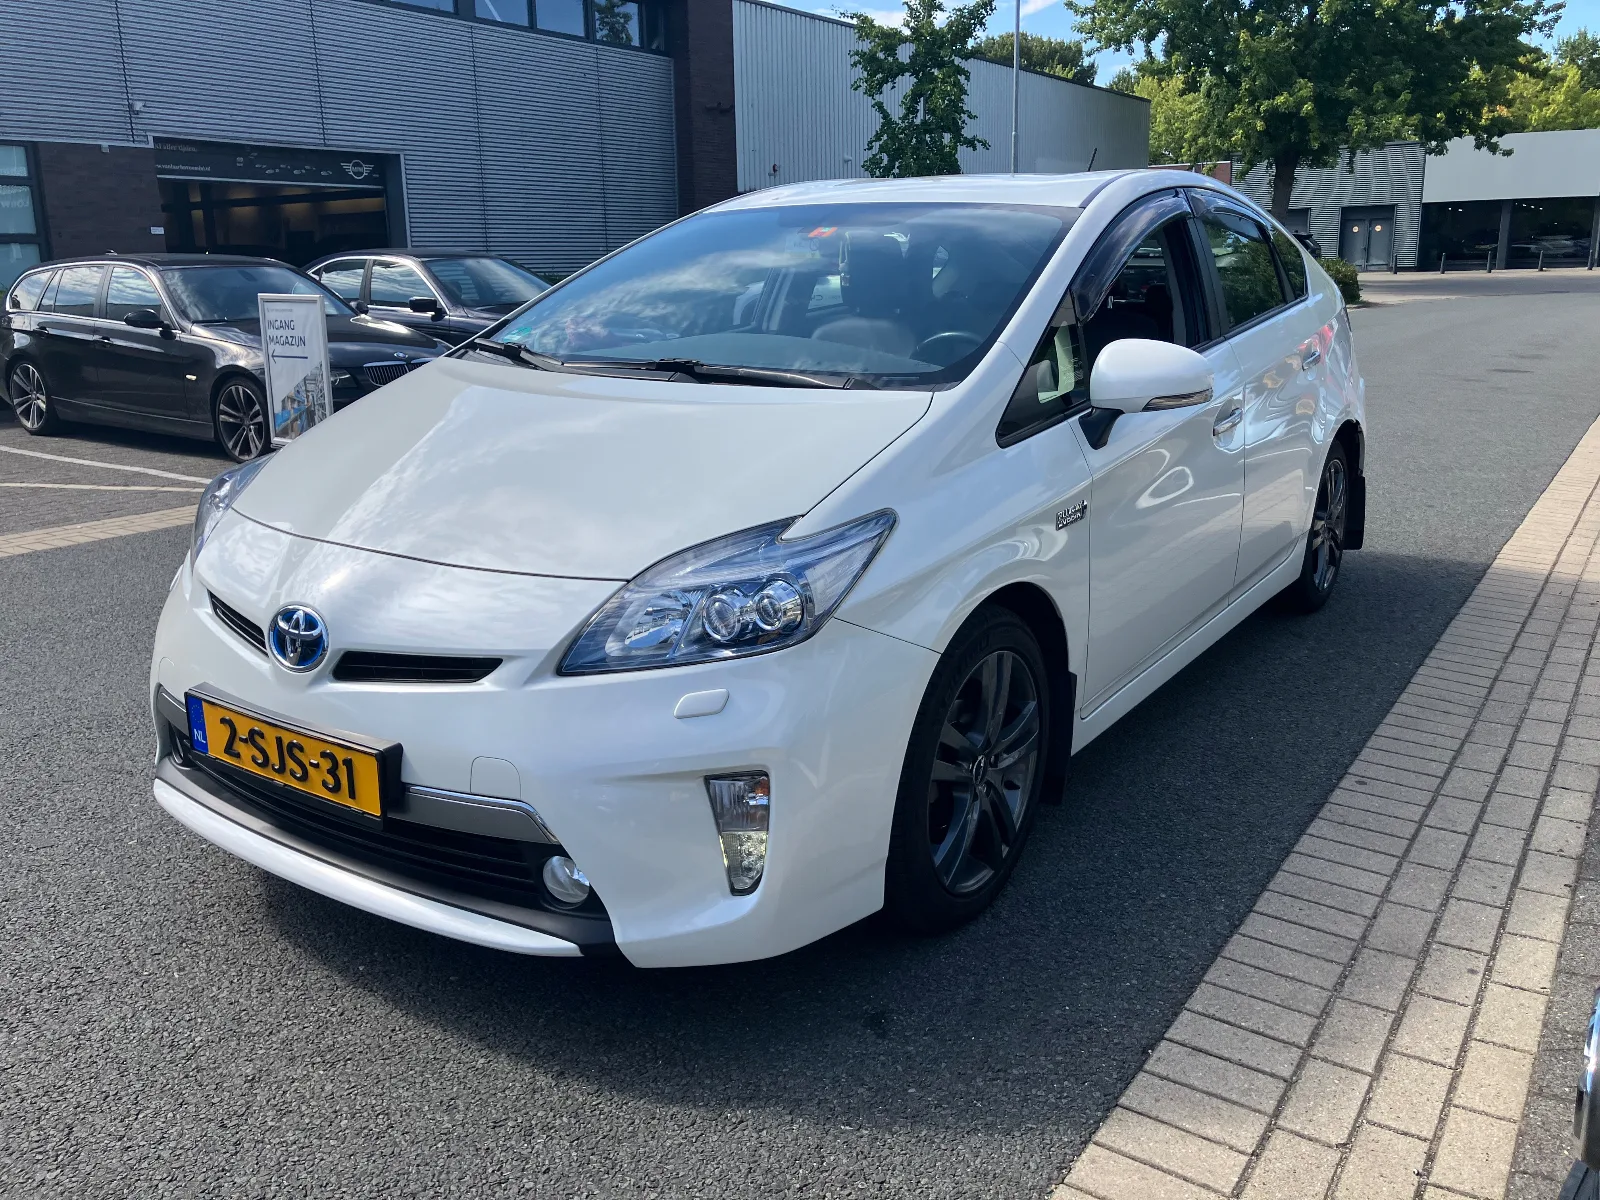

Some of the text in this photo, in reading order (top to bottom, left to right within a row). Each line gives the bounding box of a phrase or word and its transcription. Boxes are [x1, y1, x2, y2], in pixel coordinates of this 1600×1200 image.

[267, 319, 295, 331] INGANG
[268, 334, 306, 348] MAGAZIJN
[193, 728, 206, 744] NL
[219, 716, 356, 800] 2-SJS-31
